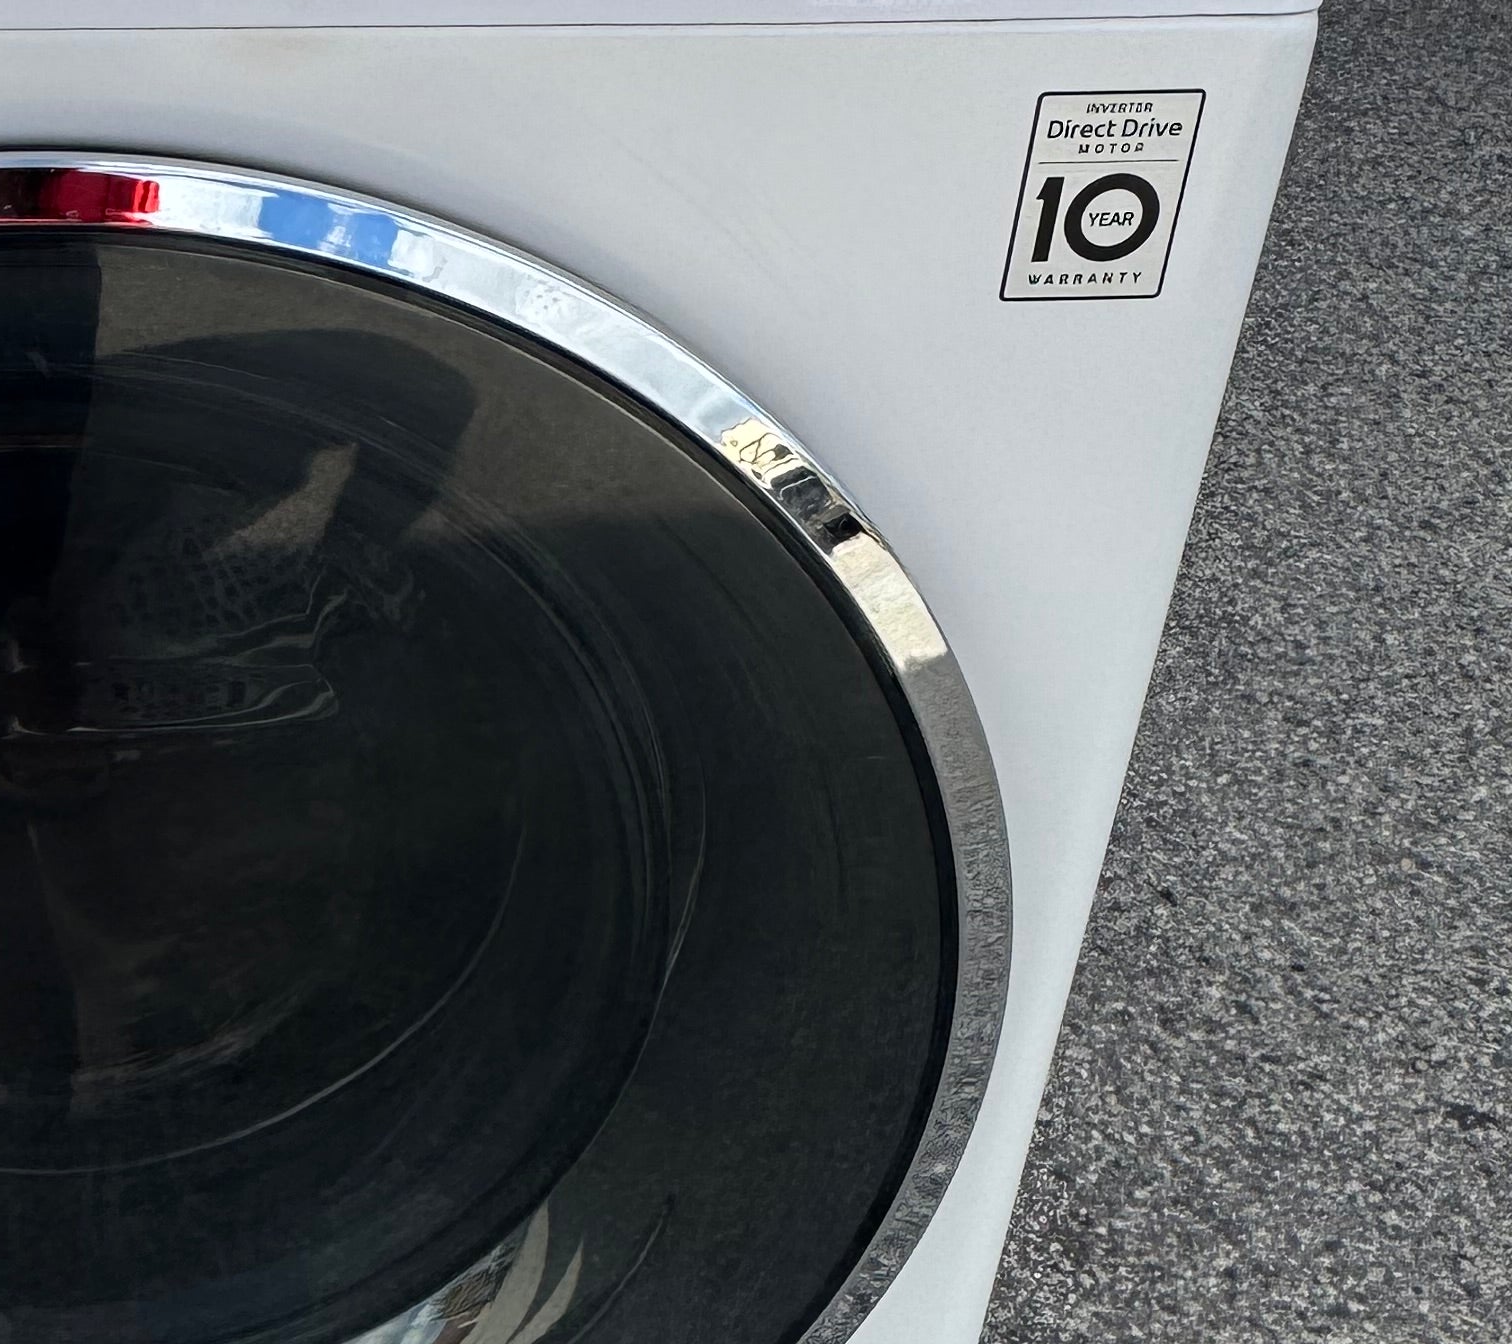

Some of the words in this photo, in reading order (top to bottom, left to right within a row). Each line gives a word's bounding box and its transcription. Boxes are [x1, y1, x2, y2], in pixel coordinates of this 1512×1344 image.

[1047, 119, 1117, 140] Direct
[1121, 117, 1184, 139] Drive
[1078, 142, 1145, 155] MOTOR
[1030, 172, 1161, 263] 10
[1088, 211, 1135, 227] YEAR
[1028, 271, 1143, 285] WARRANTY
